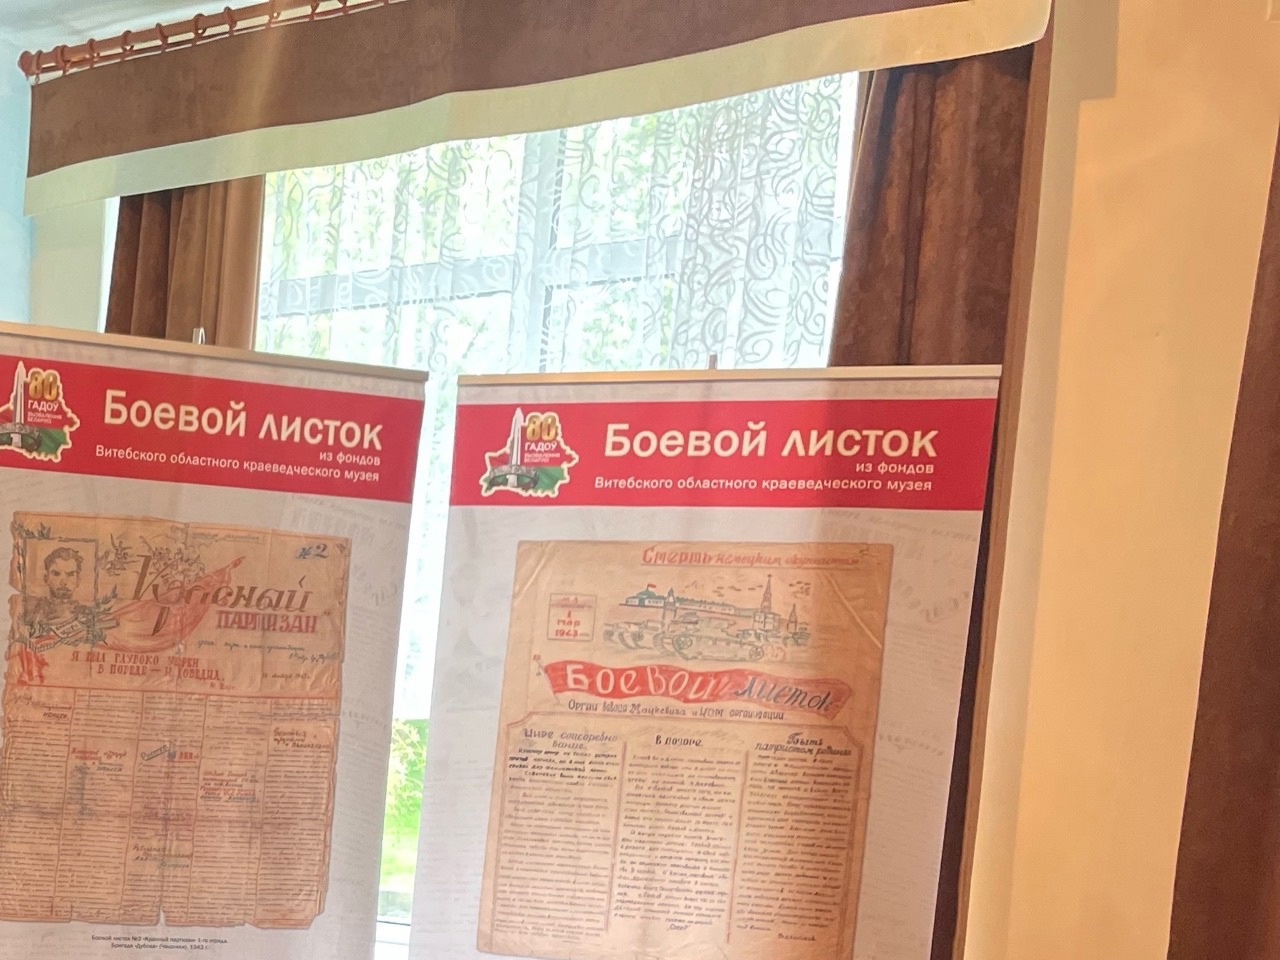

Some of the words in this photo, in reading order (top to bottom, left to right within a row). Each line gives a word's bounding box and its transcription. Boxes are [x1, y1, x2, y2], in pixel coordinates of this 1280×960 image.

[28, 370, 58, 400] 80
[27, 400, 59, 412] ГАДОЎ
[104, 389, 247, 437] Боевой
[258, 413, 383, 450] листок
[526, 415, 557, 441] 80
[604, 421, 767, 457] Боевой
[781, 429, 938, 458] листок
[95, 445, 167, 463] Витебского
[170, 452, 240, 469] областного
[243, 460, 341, 478] краеведческого
[344, 470, 379, 482] музея
[320, 451, 333, 462] из
[336, 452, 381, 466] фондов
[856, 463, 873, 473] из
[877, 461, 934, 475] фондов
[594, 476, 673, 489] Витебского
[677, 476, 757, 490] областного
[761, 479, 882, 492] краеведческого
[887, 479, 933, 492] музея
